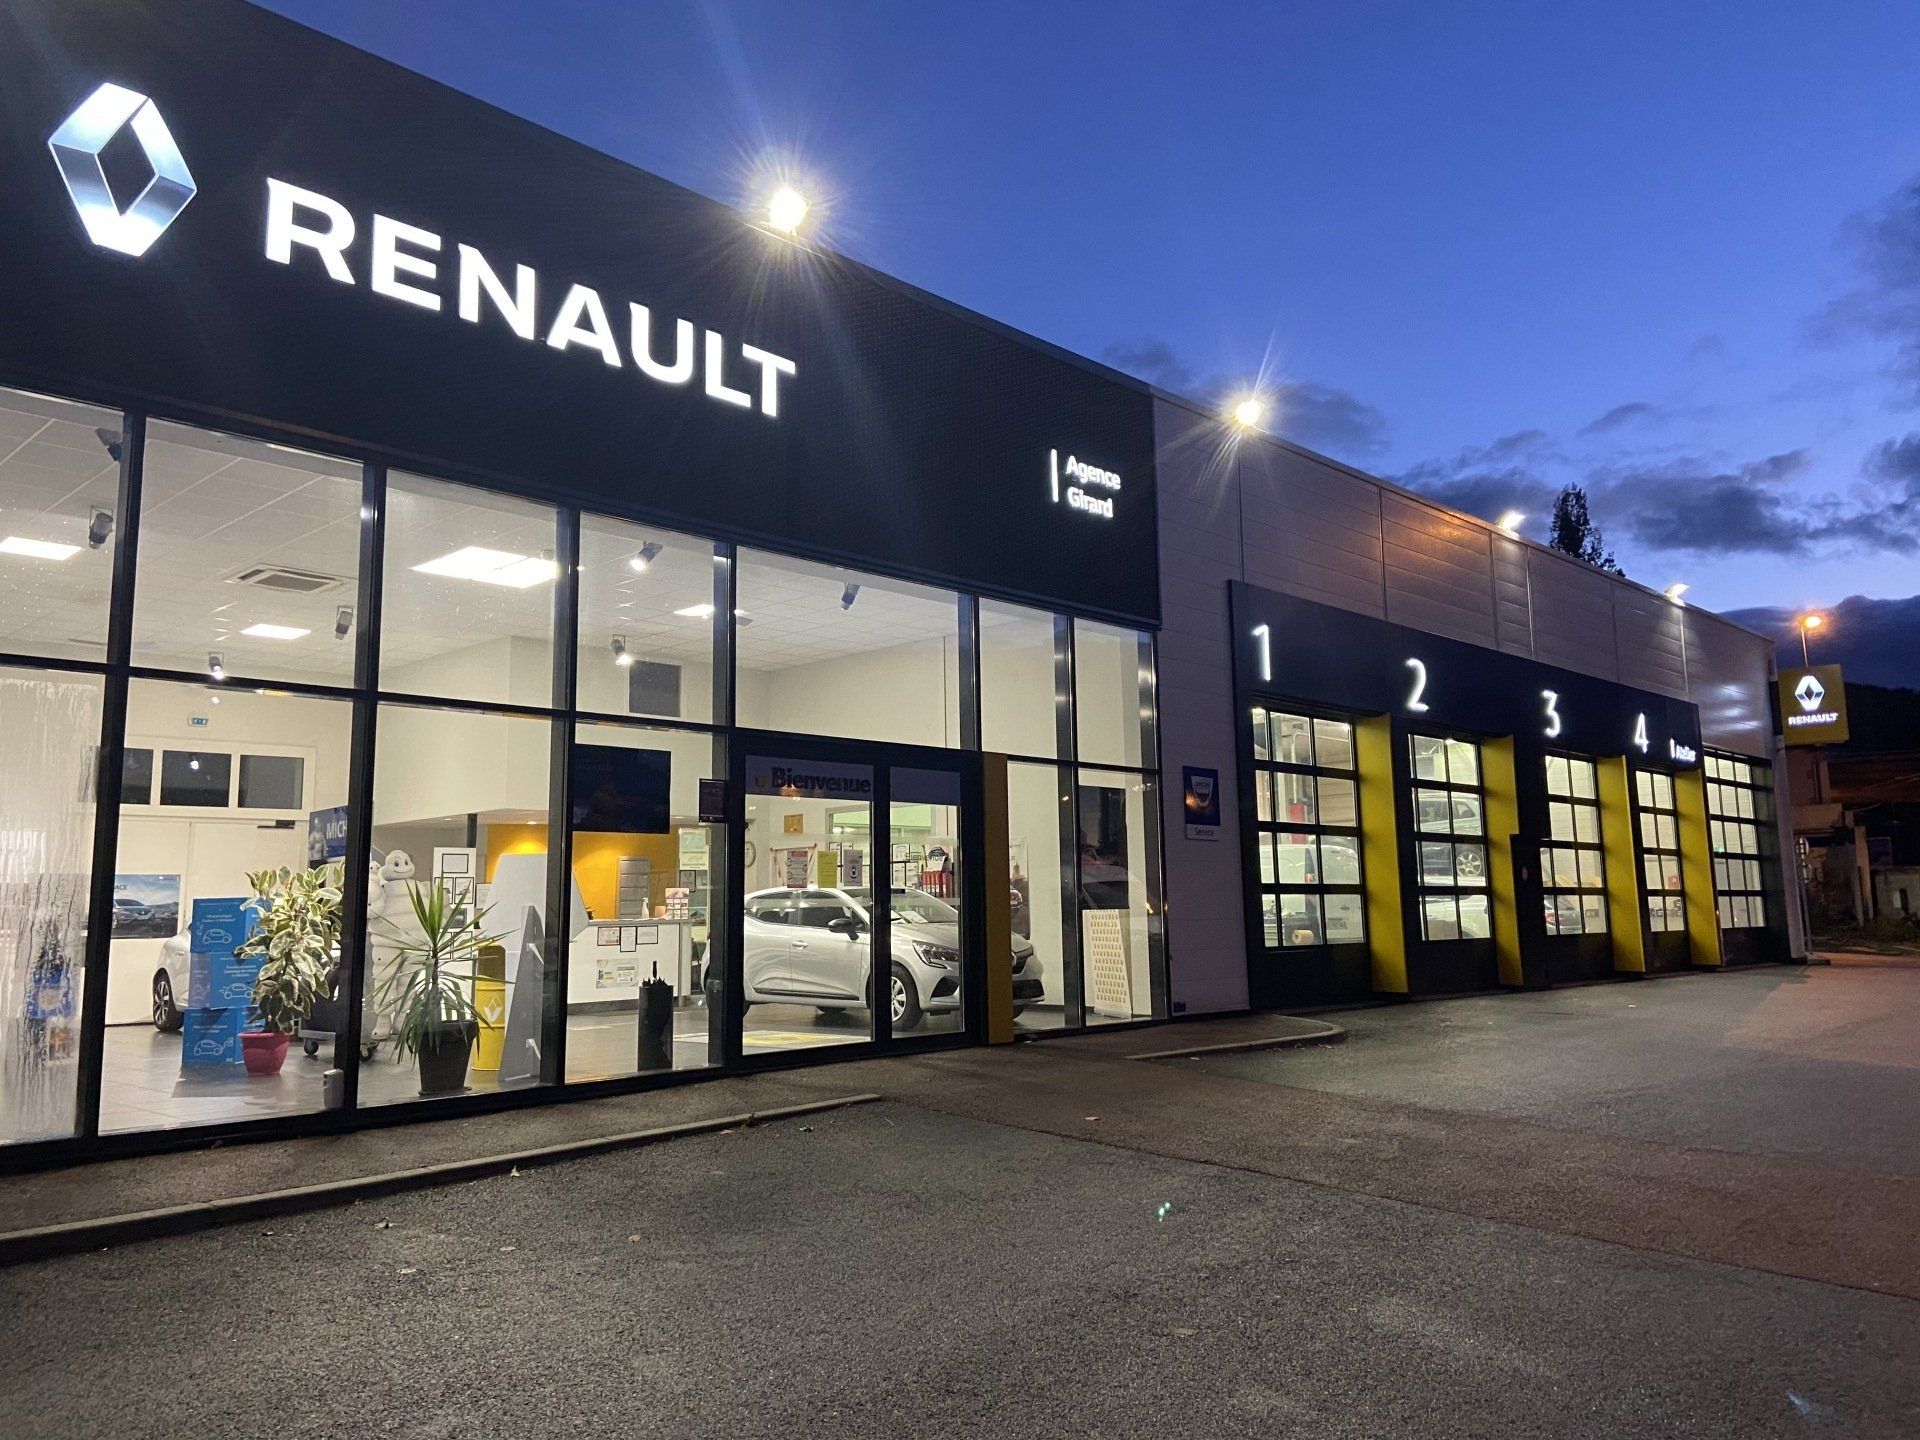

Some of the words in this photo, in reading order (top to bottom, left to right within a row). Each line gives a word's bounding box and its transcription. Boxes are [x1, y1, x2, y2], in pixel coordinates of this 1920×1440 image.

[265, 177, 796, 417] RENAULT
[1066, 455, 1121, 489] Agence
[1067, 486, 1113, 518] Girard
[1251, 624, 1271, 682] 1
[1404, 657, 1429, 712] 2
[1541, 689, 1560, 738] 3
[1634, 712, 1650, 754] 4
[1787, 712, 1839, 726] RENAULT
[771, 766, 872, 793] Bienvenue
